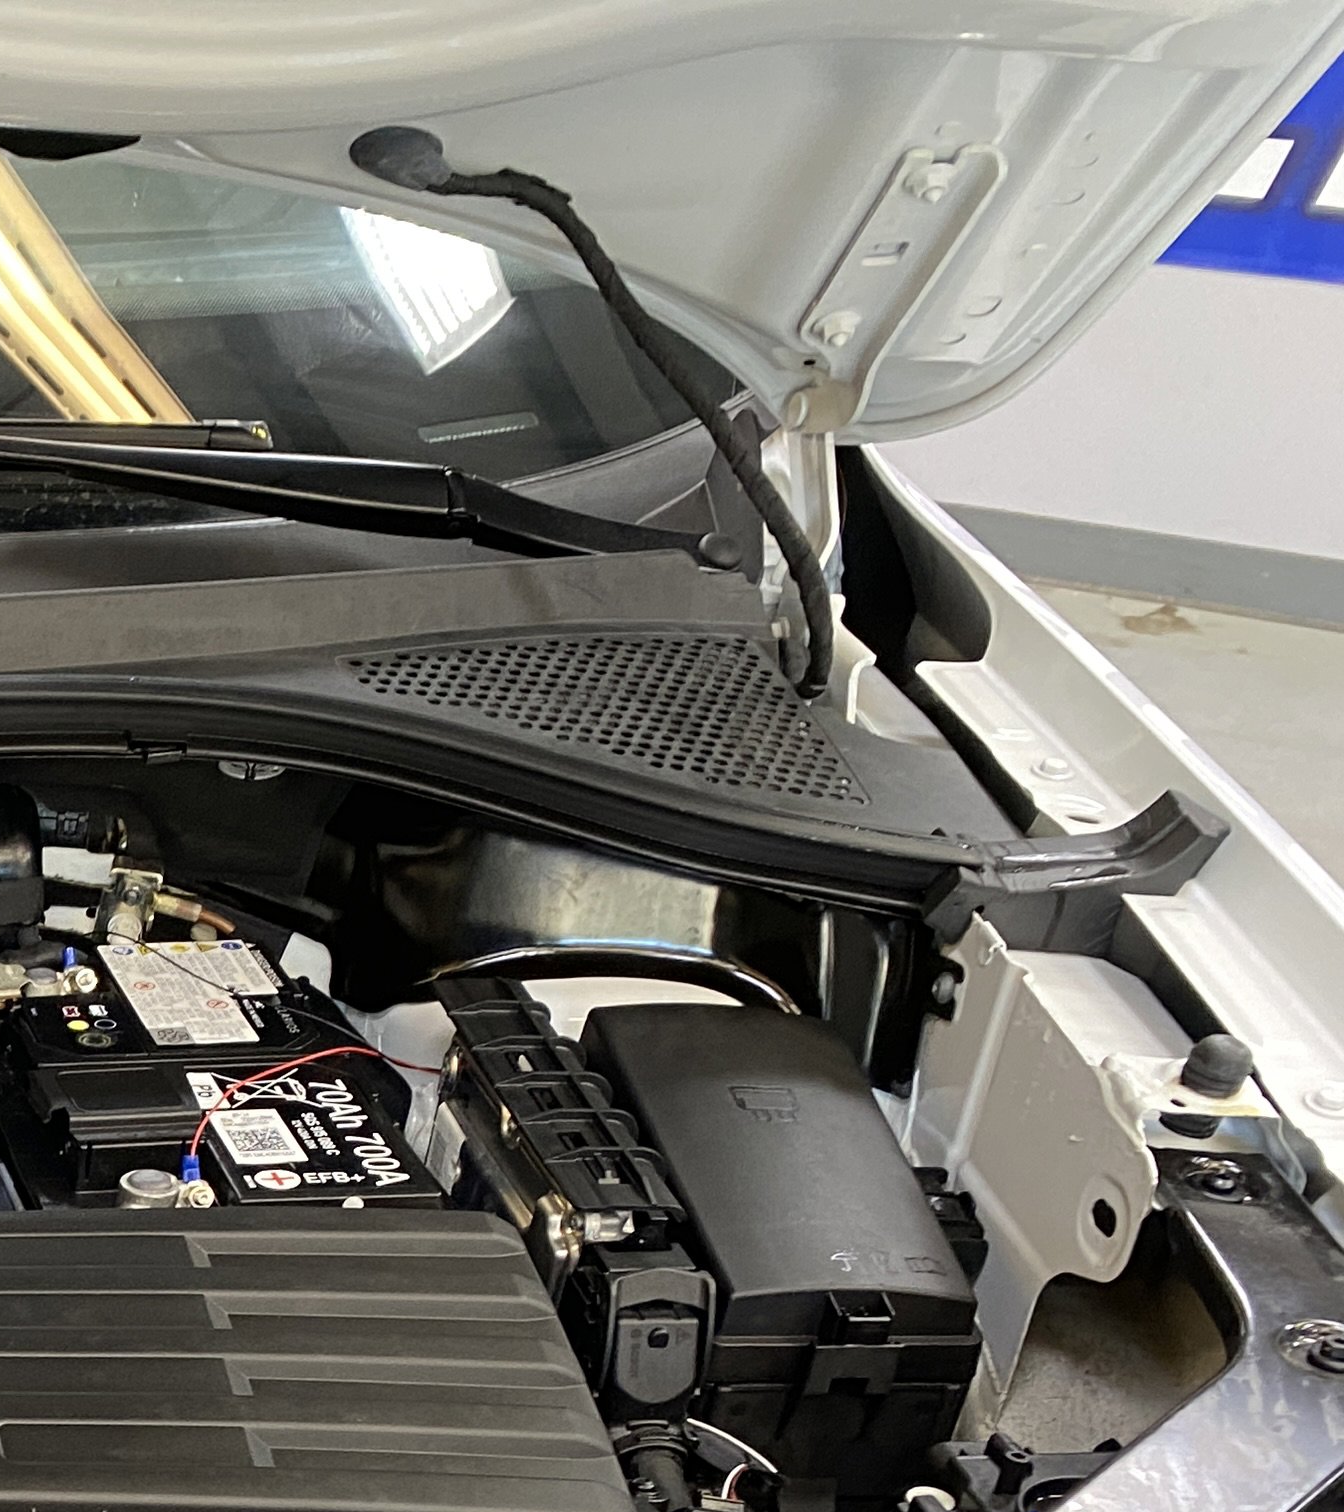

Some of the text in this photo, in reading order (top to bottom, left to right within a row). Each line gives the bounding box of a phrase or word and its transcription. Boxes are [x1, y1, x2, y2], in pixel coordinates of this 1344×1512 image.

[308, 1078, 410, 1187] 70Ah 700A
[302, 1171, 366, 1185] EFB+
